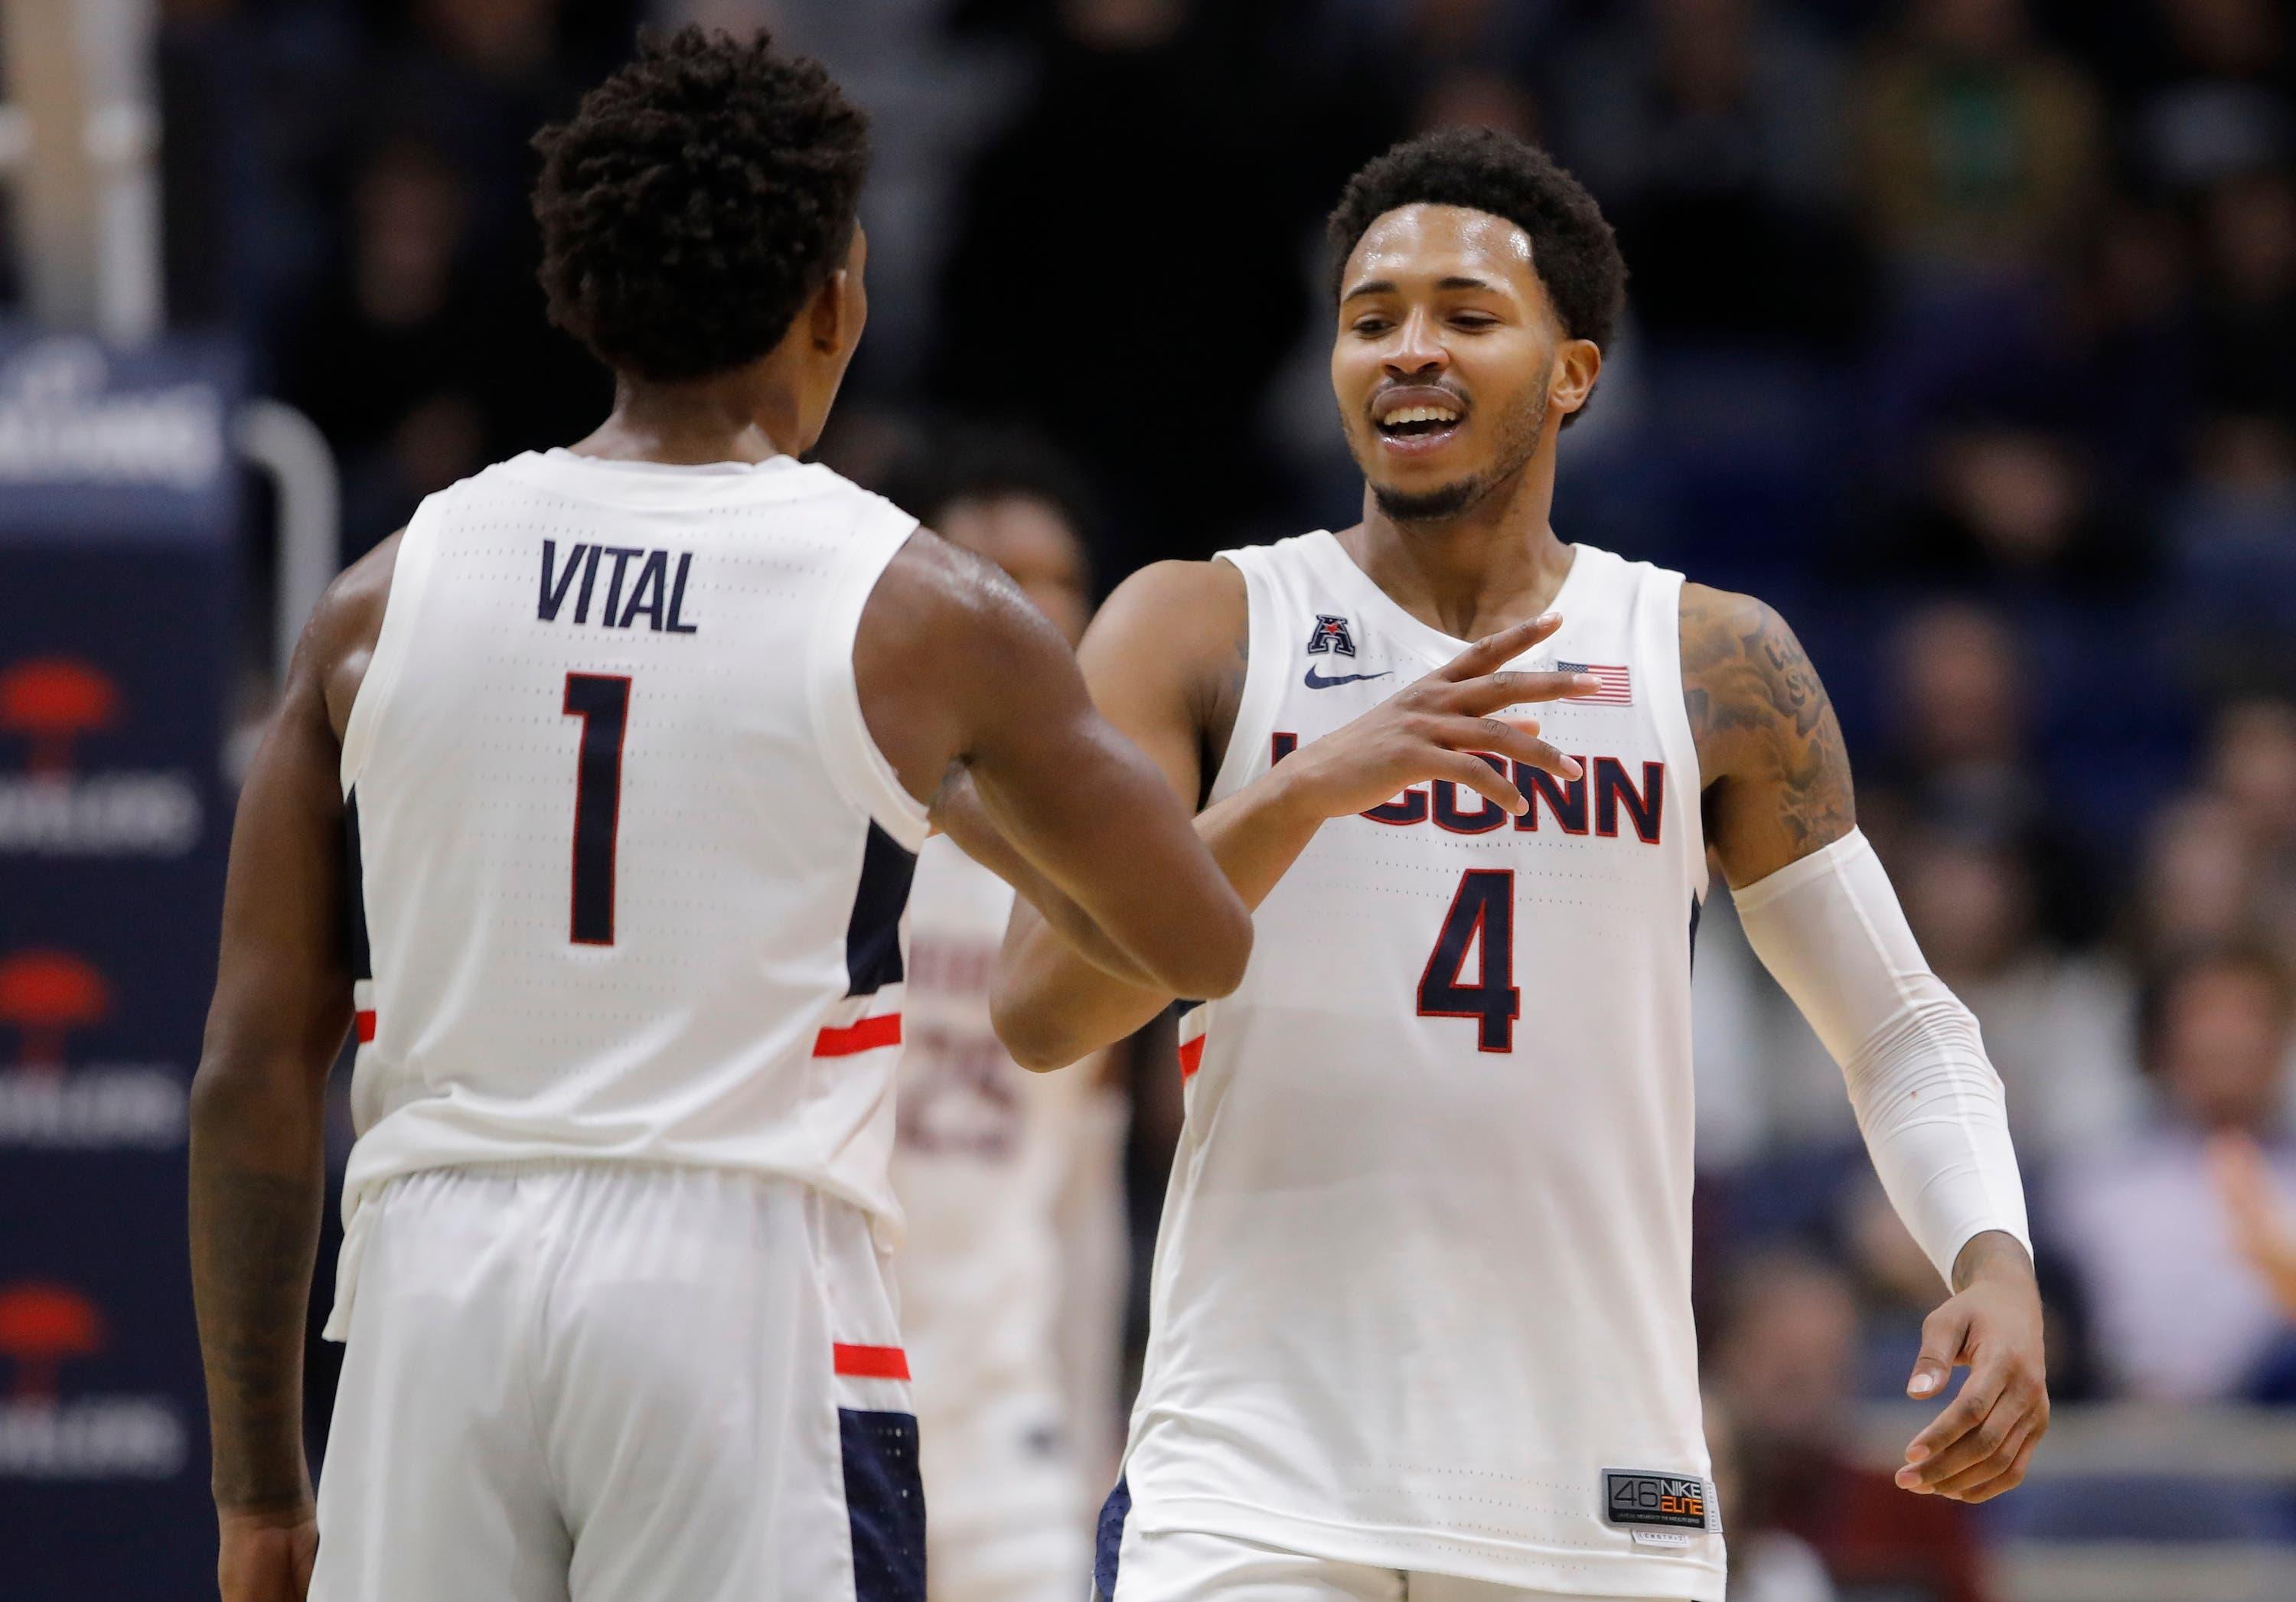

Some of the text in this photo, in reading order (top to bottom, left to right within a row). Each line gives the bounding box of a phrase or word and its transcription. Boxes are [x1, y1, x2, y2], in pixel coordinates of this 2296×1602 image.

[537, 538, 697, 635] VITAL
[562, 670, 633, 946] 1
[1416, 868, 1521, 1054] 4
[1614, 1480, 1658, 1508] 46
[1660, 1479, 1702, 1498] NIKE
[1660, 1496, 1704, 1516] ELITE
